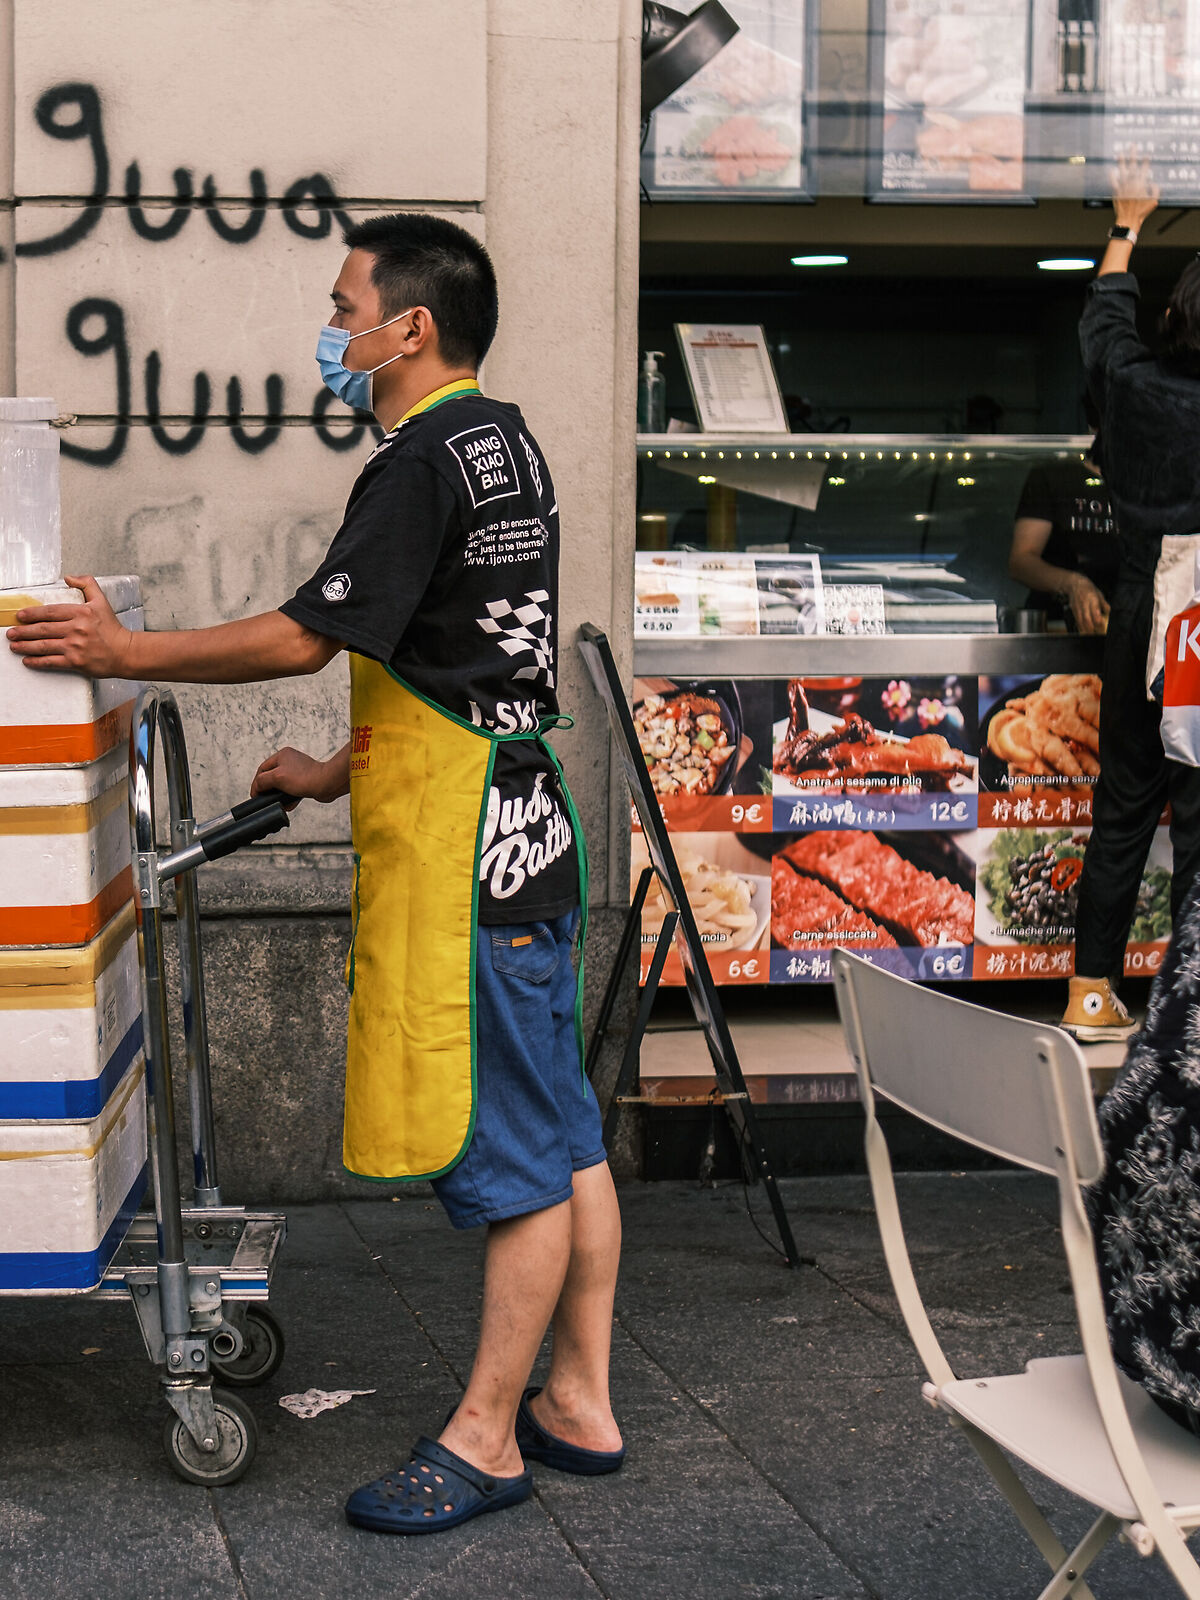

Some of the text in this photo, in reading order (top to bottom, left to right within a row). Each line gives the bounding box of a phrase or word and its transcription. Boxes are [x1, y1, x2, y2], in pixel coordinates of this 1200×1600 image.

[464, 435, 501, 460] JIANG
[472, 452, 505, 476] XIAO
[796, 776, 833, 786] Anatra
[834, 776, 844, 786] al
[846, 776, 887, 786] sesamo
[889, 775, 900, 786] di
[1000, 774, 1069, 786] Agropiccante
[731, 804, 763, 823] 9€
[929, 801, 969, 822] 12€
[793, 930, 823, 940] Carne
[996, 925, 1075, 936] Lumache di fan
[729, 960, 761, 978] 6€
[933, 956, 964, 974] 6€
[1124, 951, 1162, 969] 10€
